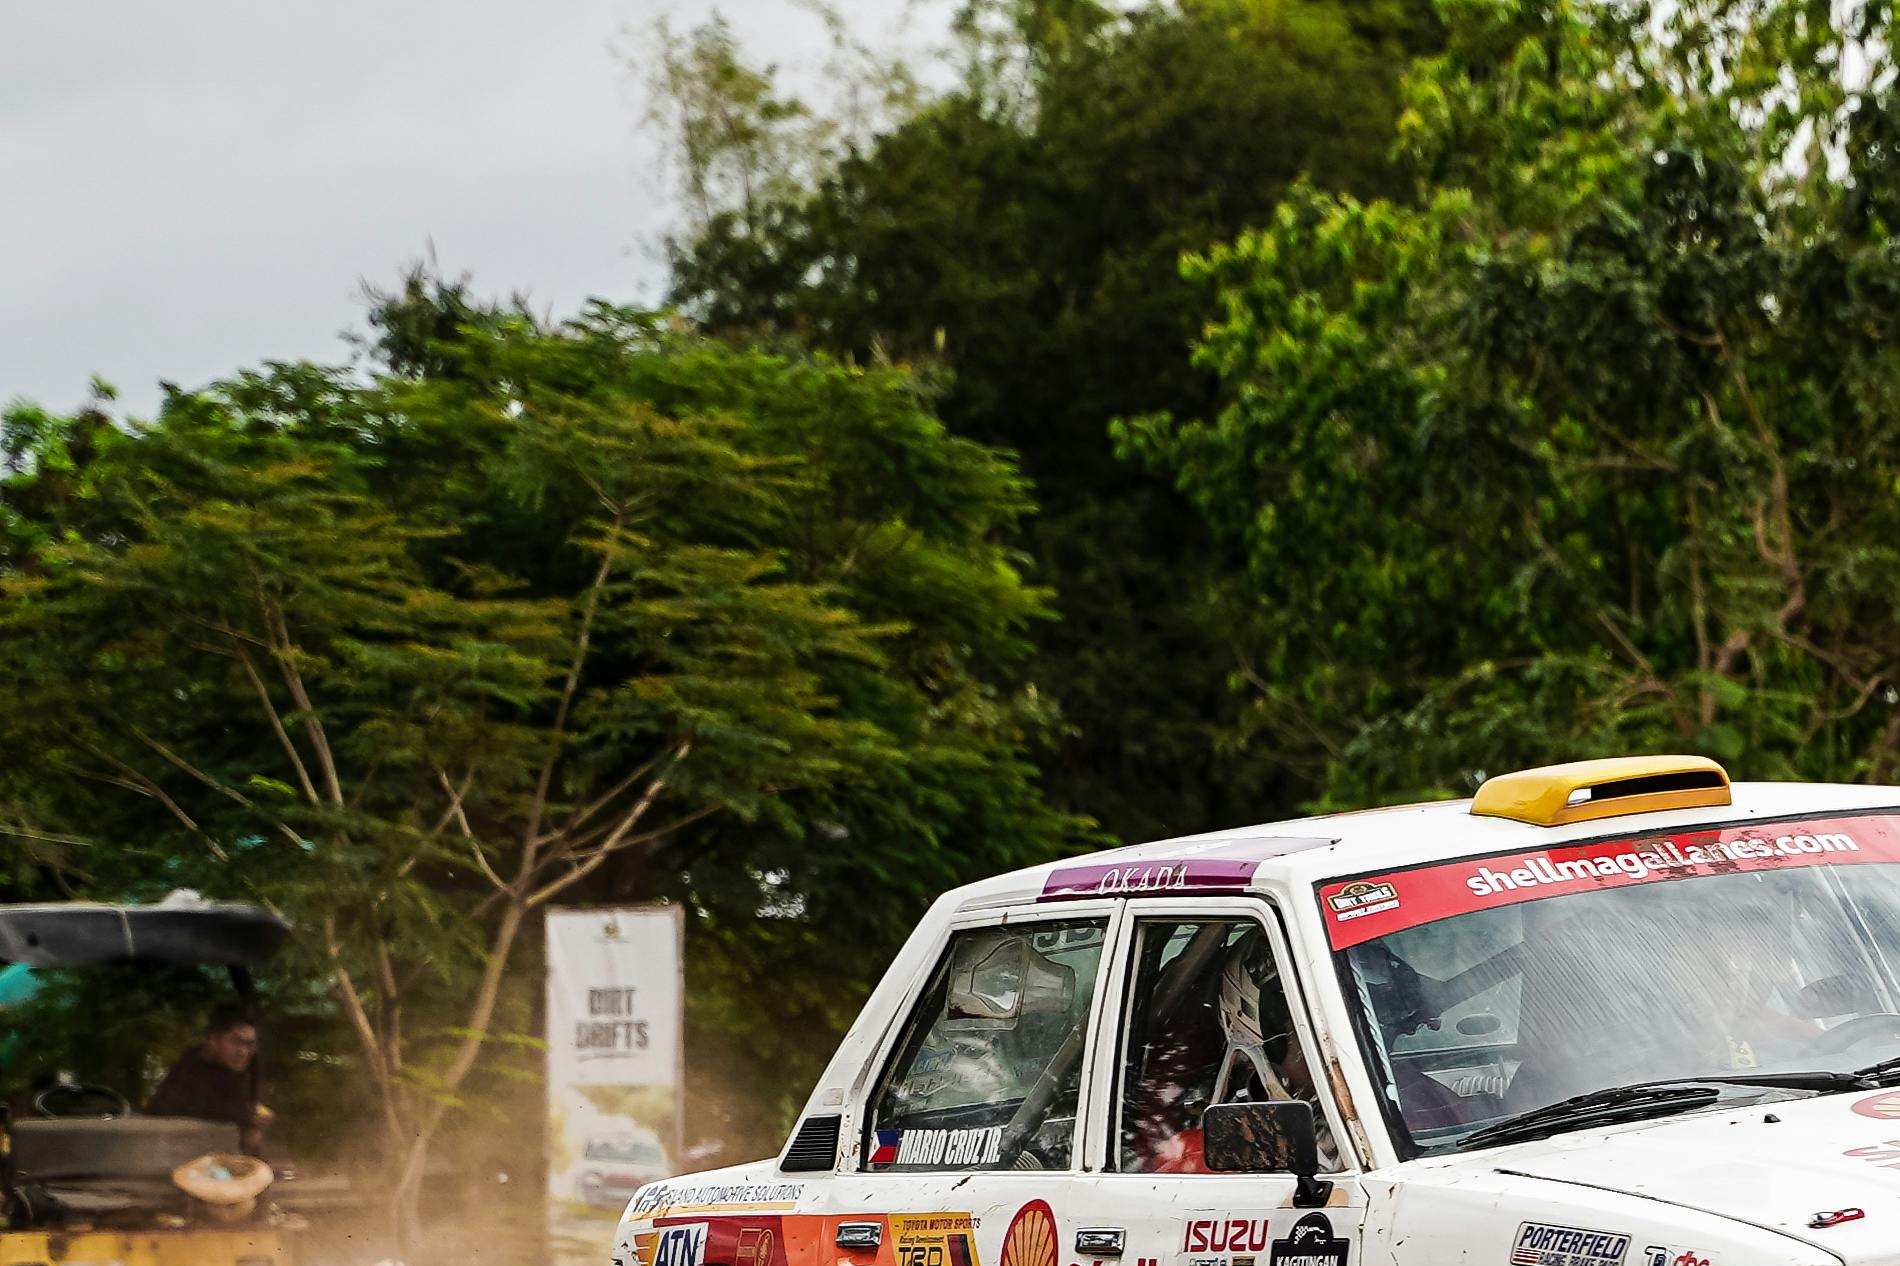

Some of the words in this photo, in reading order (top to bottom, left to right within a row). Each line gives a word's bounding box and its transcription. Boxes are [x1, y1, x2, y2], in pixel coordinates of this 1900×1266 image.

[1100, 866, 1188, 893] OKADA
[1466, 832, 1860, 897] shellmagallanes.com
[897, 1129, 946, 1165] MARIO
[944, 1128, 983, 1165] CRUZ
[750, 1184, 805, 1201] SOLUTIONS
[1184, 1220, 1269, 1252] ISUZU
[1519, 1226, 1627, 1260] PORTERFIELD
